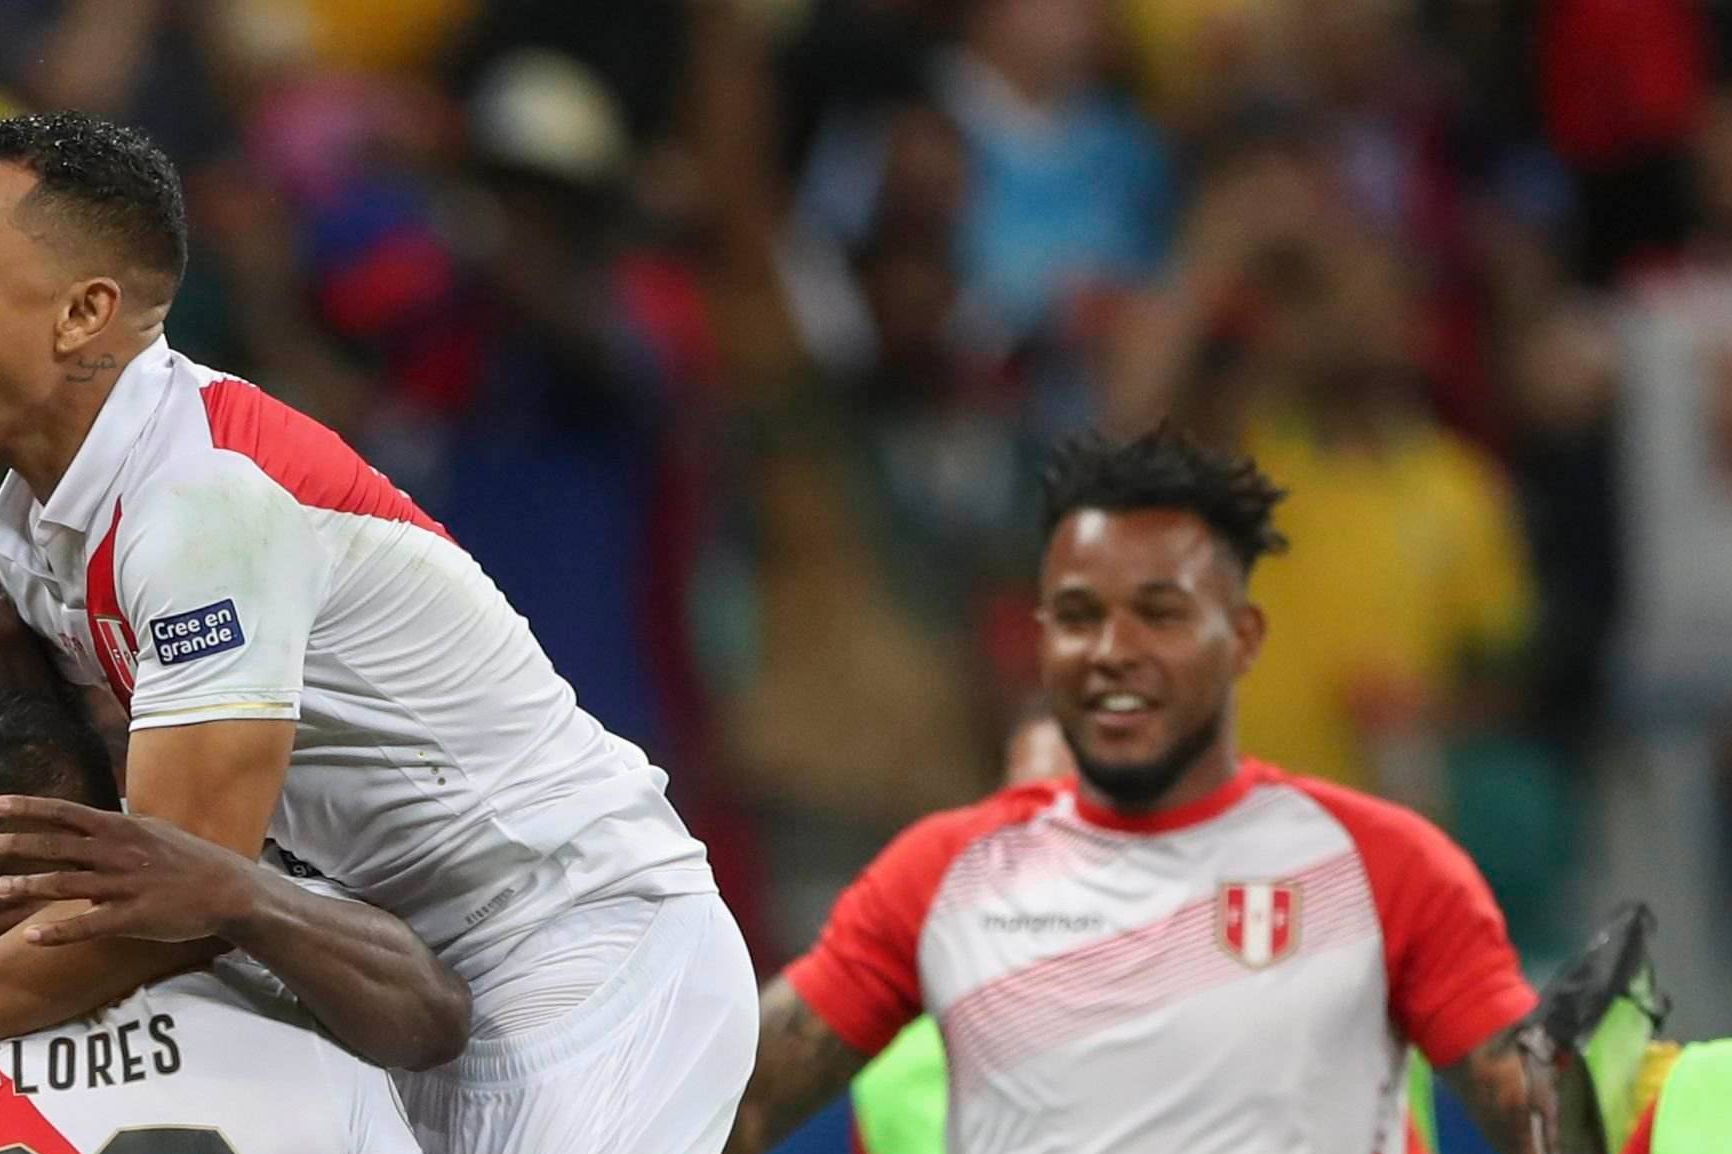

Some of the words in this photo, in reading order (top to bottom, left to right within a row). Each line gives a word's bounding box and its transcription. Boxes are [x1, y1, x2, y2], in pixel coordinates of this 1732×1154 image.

[154, 618, 200, 640] Cree
[205, 608, 231, 631] en
[159, 628, 233, 662] grande
